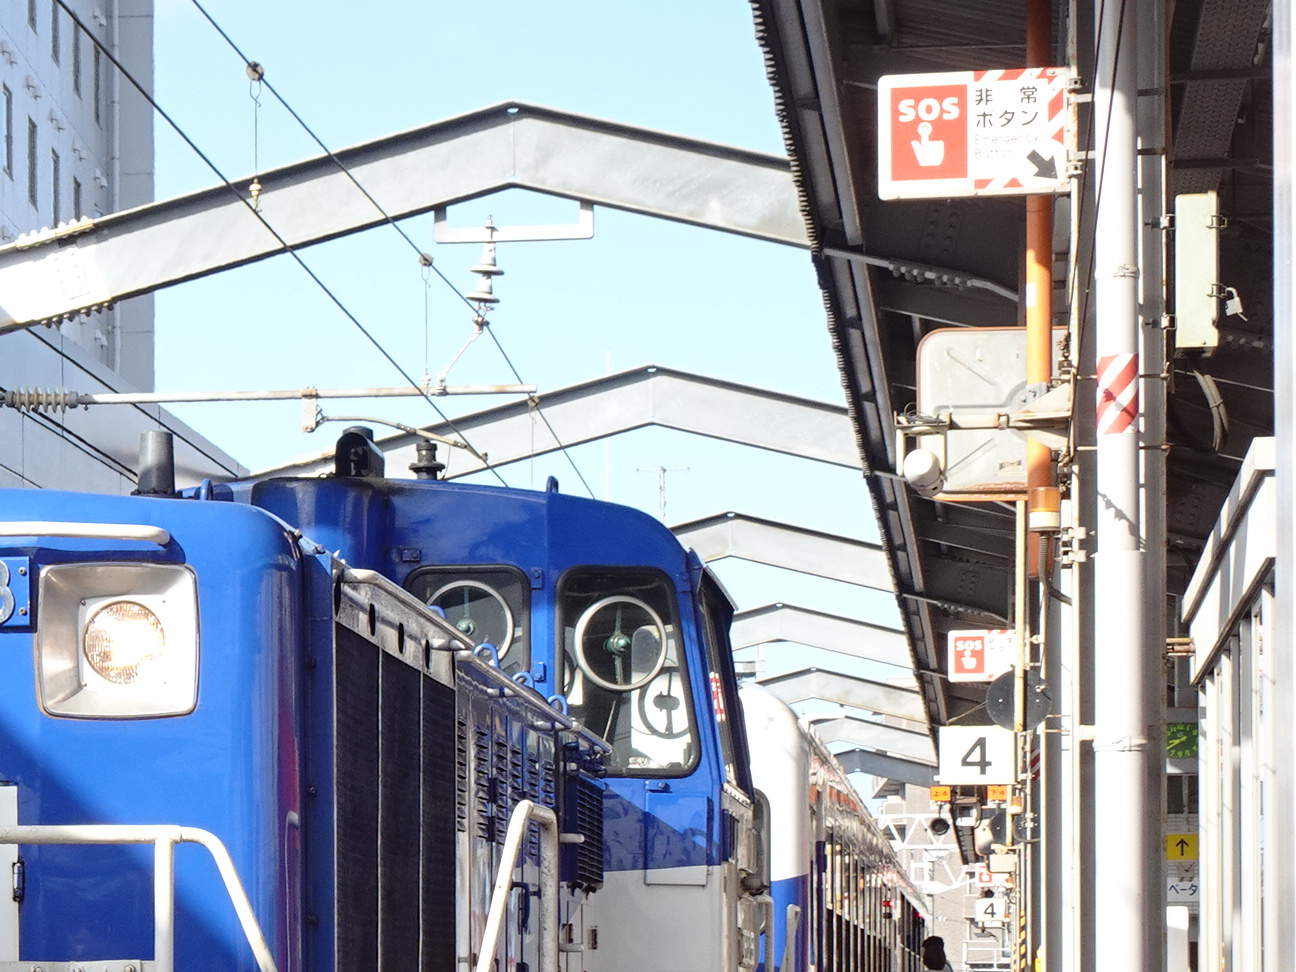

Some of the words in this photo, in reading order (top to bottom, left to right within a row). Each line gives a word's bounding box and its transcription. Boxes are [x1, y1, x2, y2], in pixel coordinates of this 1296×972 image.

[898, 97, 960, 122] SOS
[976, 110, 1038, 128] ボタン
[974, 134, 1039, 145] Emergency
[974, 148, 1014, 159] Button
[955, 640, 983, 651] SOS
[960, 736, 992, 776] 4
[984, 902, 997, 918] 4
